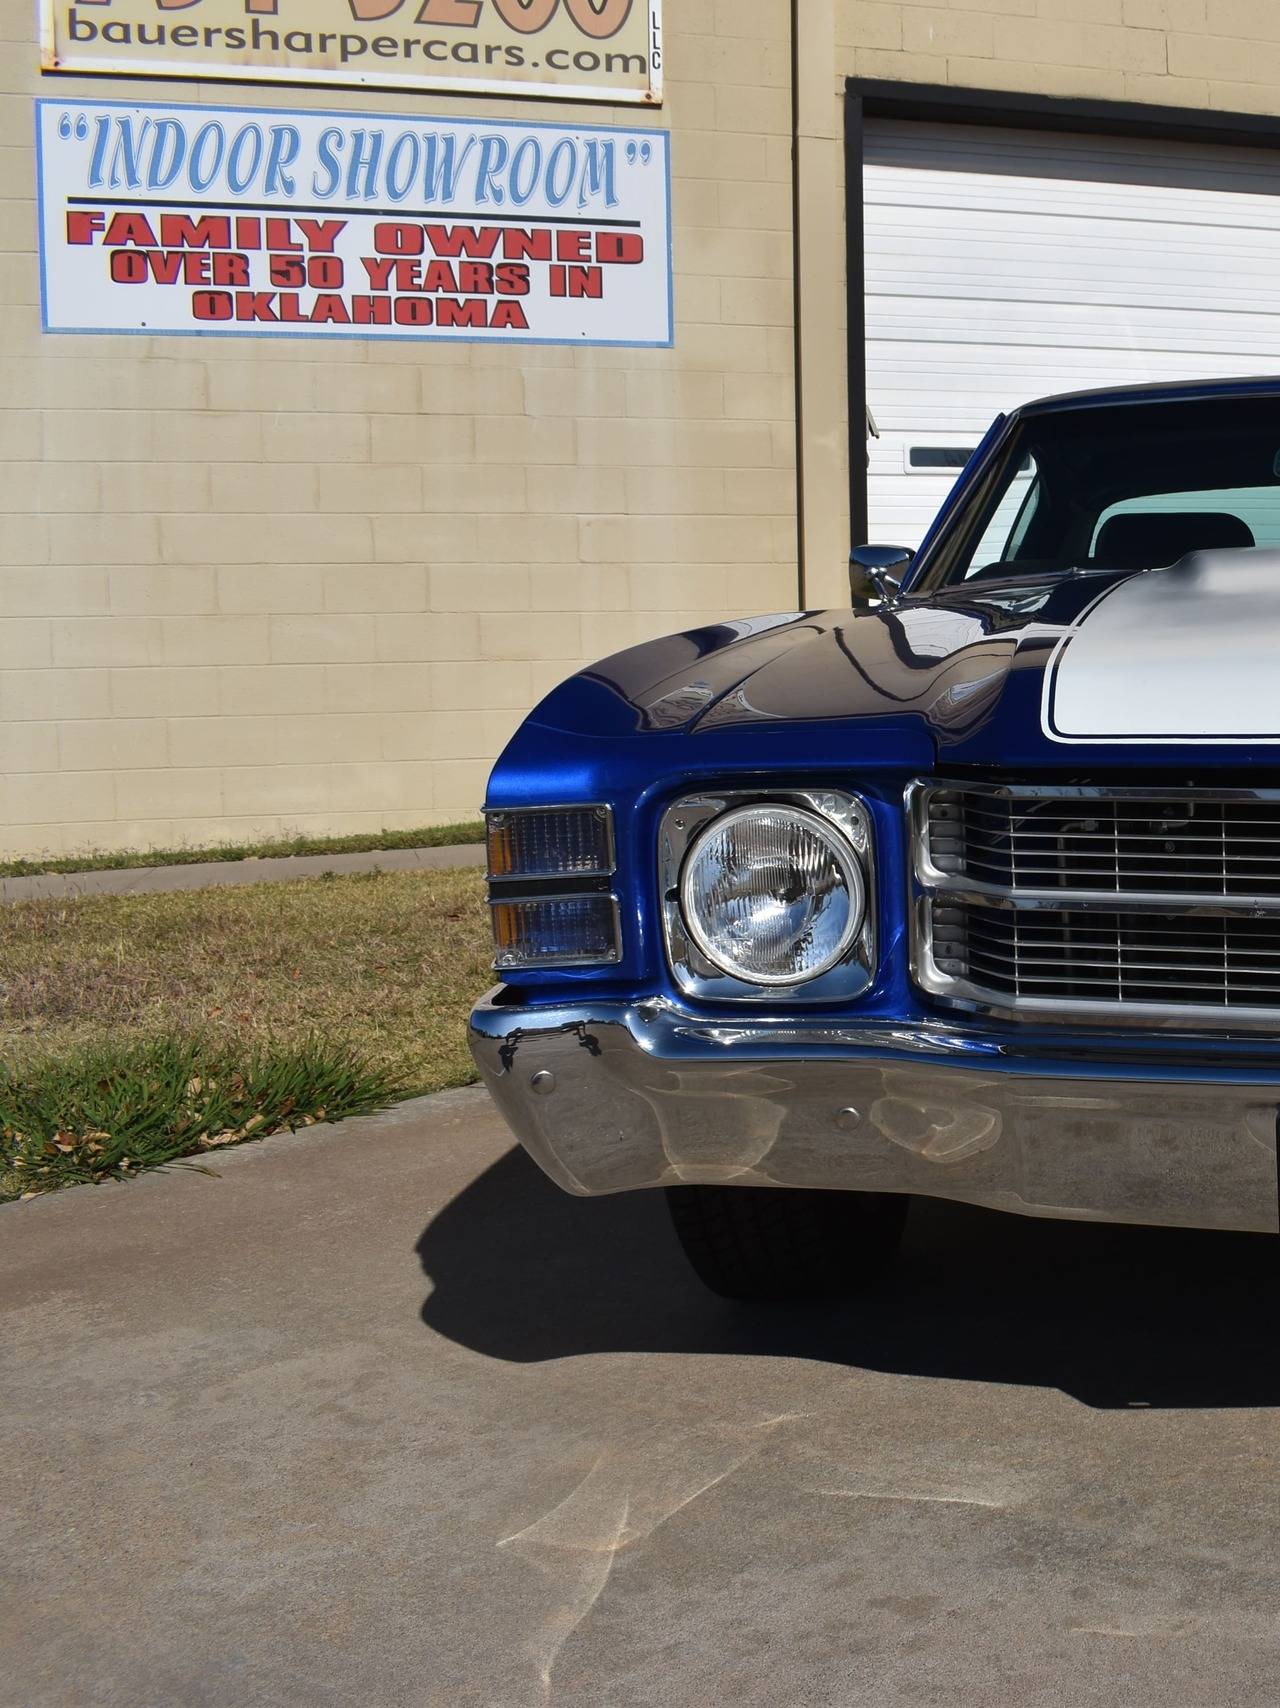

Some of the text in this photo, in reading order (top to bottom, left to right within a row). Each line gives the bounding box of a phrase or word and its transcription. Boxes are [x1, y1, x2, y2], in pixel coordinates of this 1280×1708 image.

[68, 8, 648, 74] bauersharpercars.com
[652, 11, 661, 70] LLC
[66, 211, 644, 265] FAMILY OWNED
[110, 249, 603, 299] OVER 50 YEARS IN
[192, 290, 530, 330] OKLAHOMA
